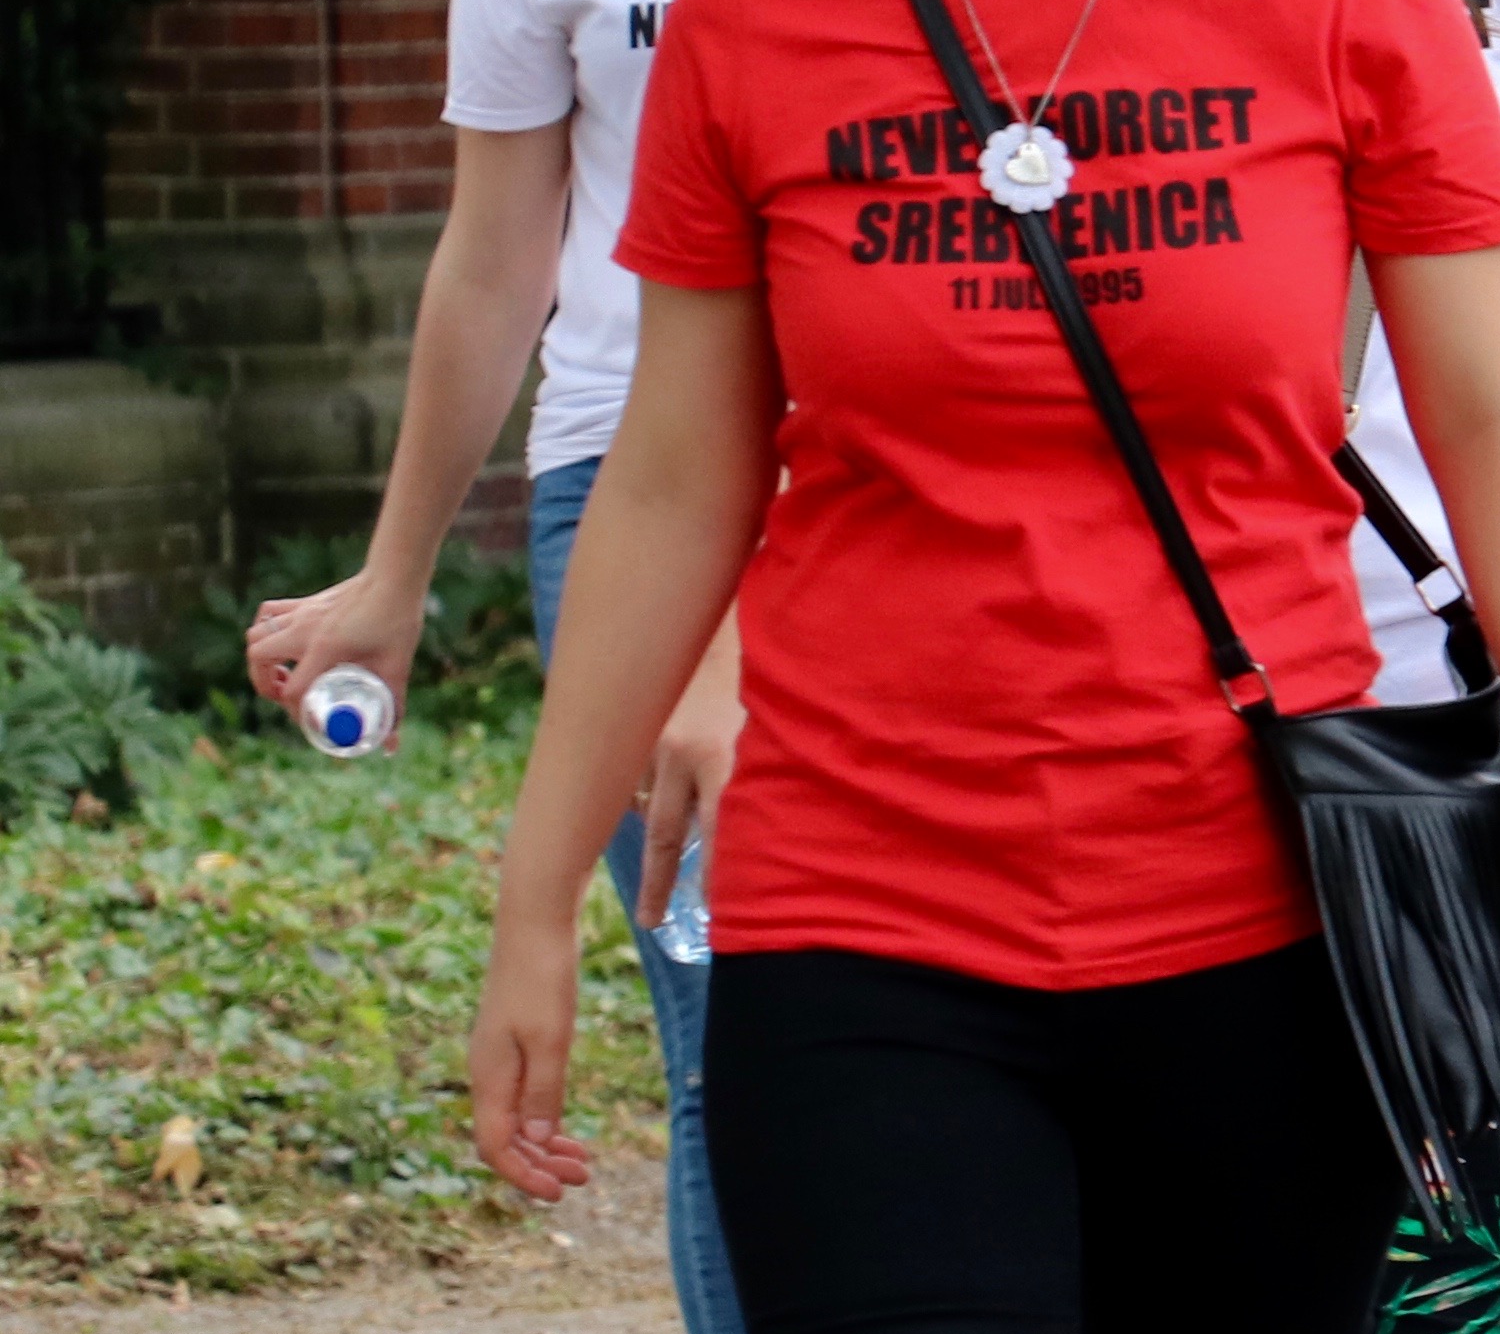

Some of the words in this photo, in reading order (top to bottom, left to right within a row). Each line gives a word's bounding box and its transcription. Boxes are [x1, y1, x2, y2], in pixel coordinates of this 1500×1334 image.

[827, 101, 1012, 181] NEVE
[851, 178, 1243, 264] SREBENICA
[950, 278, 979, 310] 11
